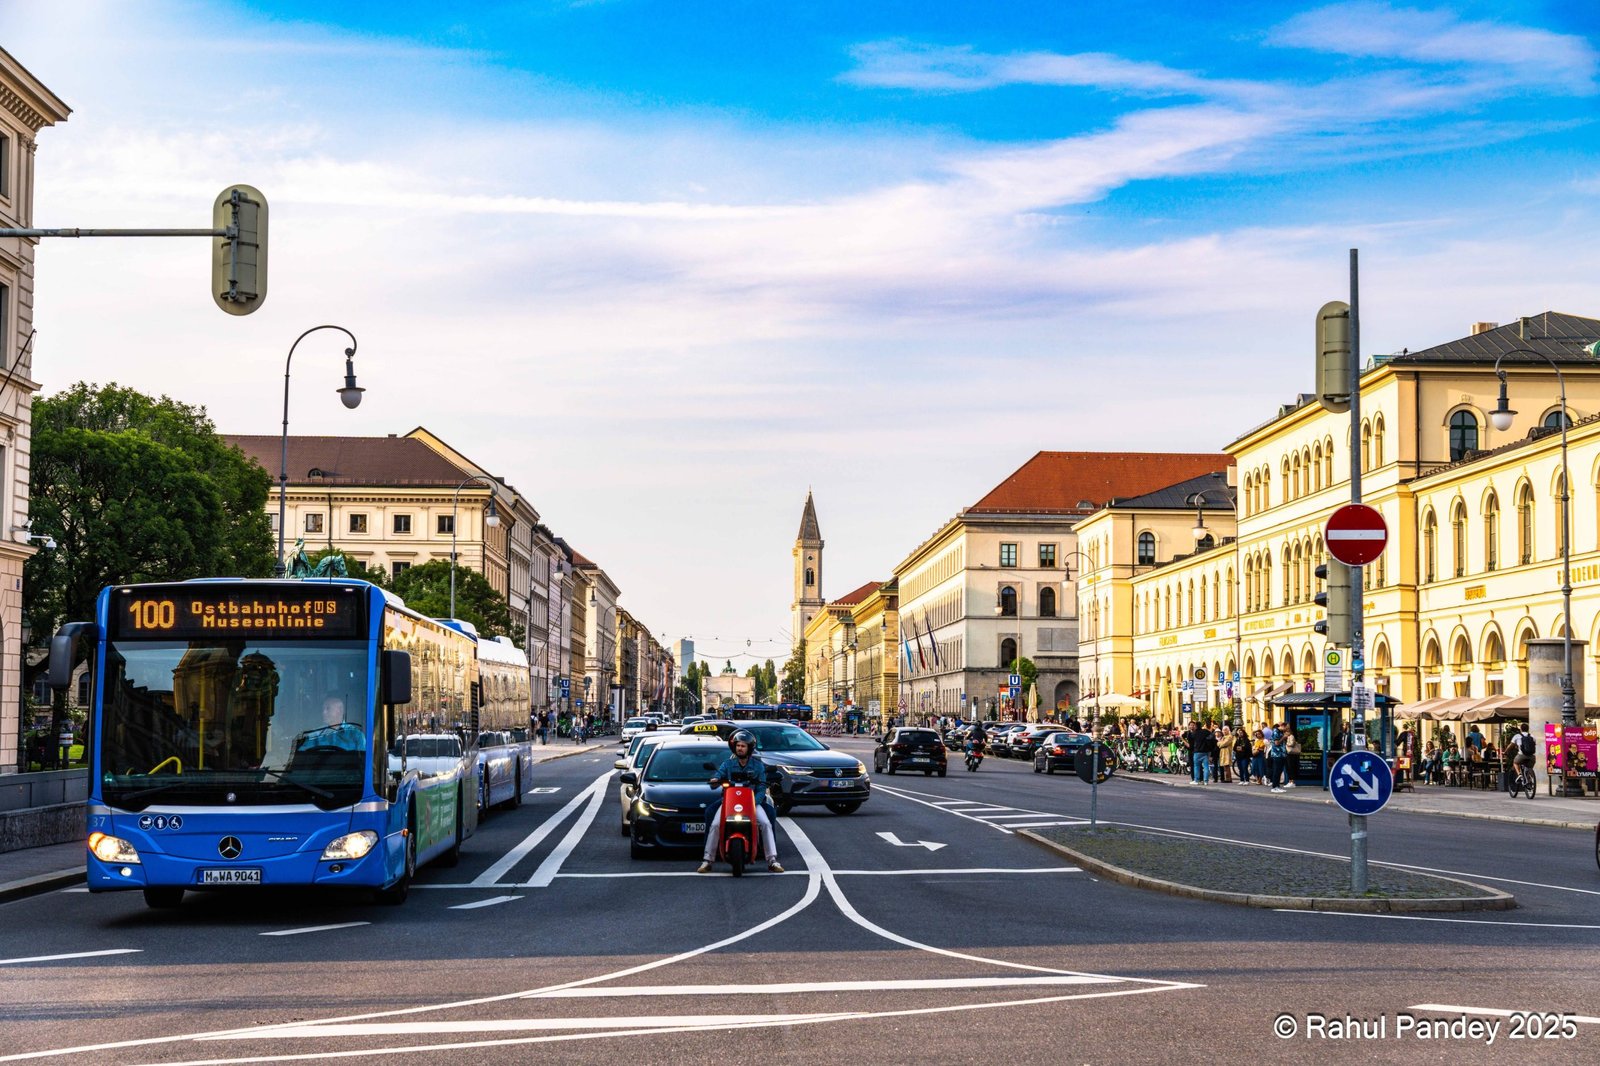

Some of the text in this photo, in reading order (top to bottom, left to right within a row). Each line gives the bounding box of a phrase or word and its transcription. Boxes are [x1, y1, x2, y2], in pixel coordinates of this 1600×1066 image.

[191, 601, 336, 614] Ostbahnhof U S
[129, 600, 175, 629] 100
[202, 614, 324, 628] Museenlinie
[1012, 676, 1018, 684] U
[205, 870, 260, 881] M WA 9041
